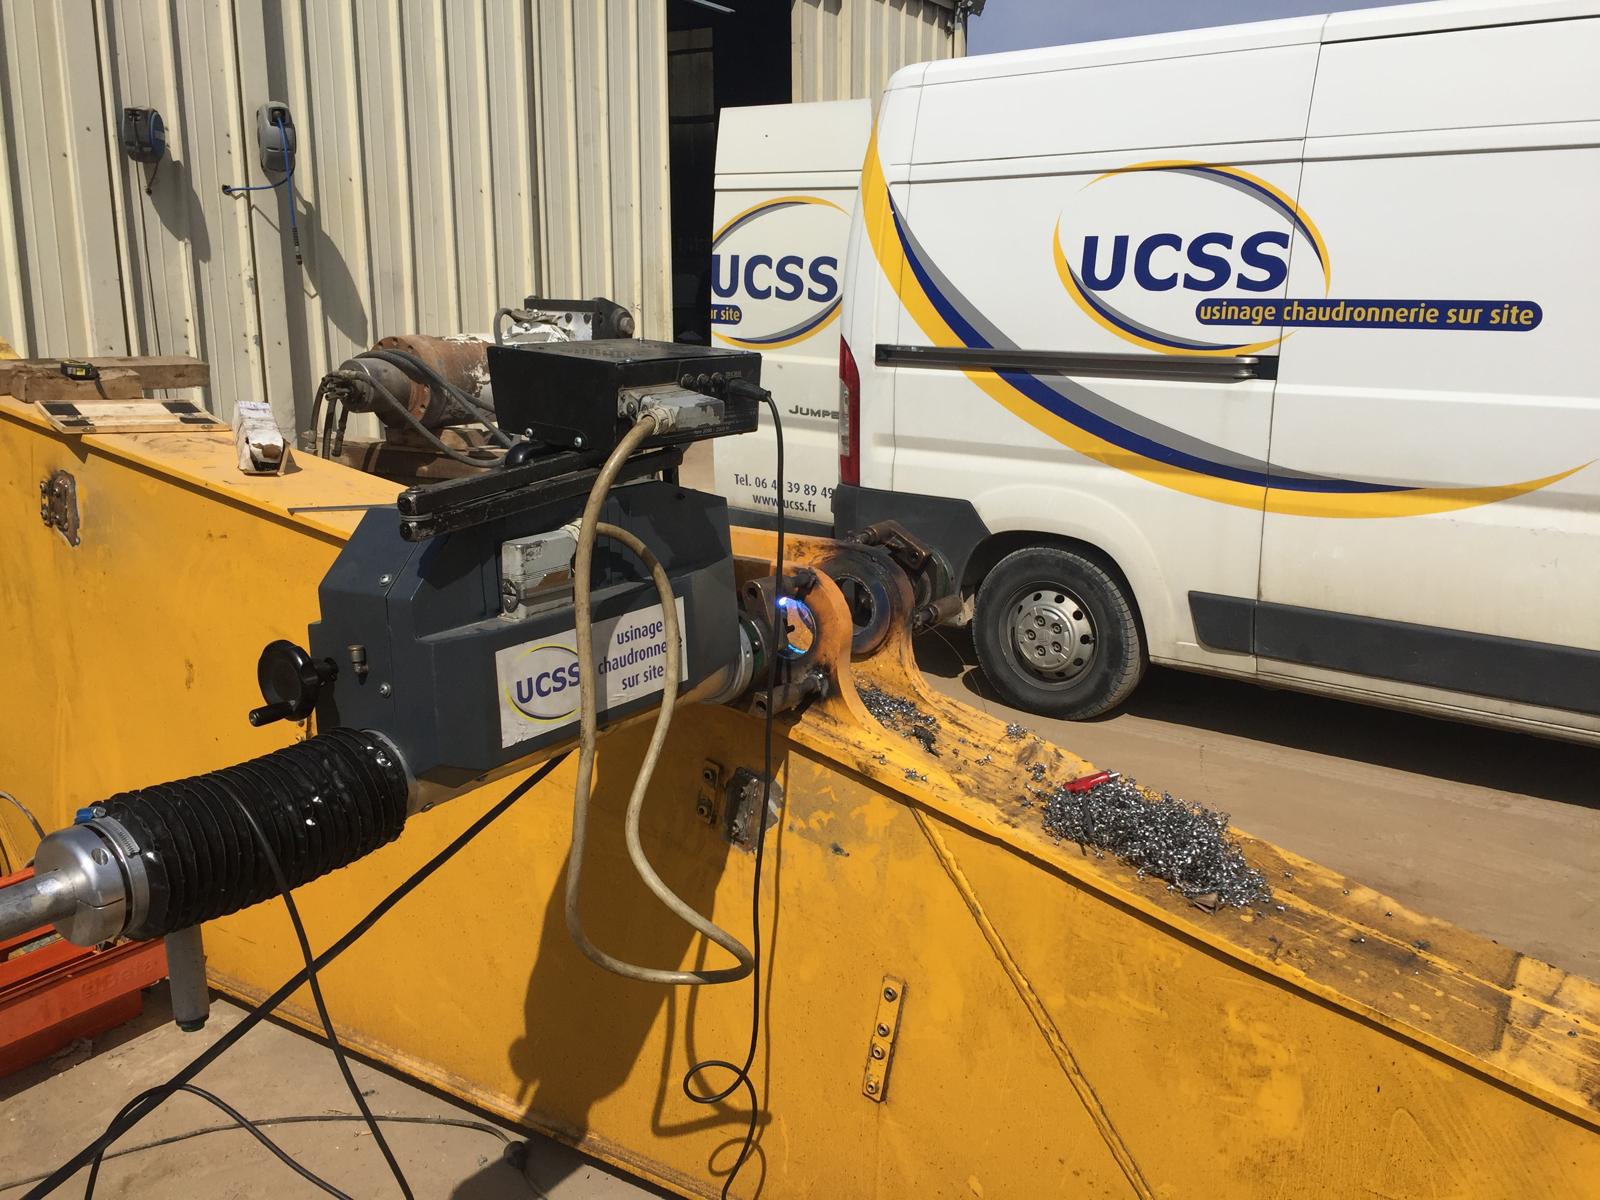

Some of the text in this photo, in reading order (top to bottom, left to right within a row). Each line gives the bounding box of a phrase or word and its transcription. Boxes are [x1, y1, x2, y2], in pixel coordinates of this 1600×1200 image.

[1080, 231, 1290, 292] UCSS
[711, 254, 838, 302] UCSS
[720, 306, 741, 321] site
[1199, 300, 1534, 326] usinage chaudronnerie sur site
[789, 405, 839, 420] JUMPE
[734, 473, 752, 487] Tel.
[754, 477, 768, 489] 06
[787, 481, 800, 494] 39
[803, 484, 817, 496] 89
[820, 487, 833, 499] 49
[752, 494, 817, 513] wwwucss.fr
[616, 620, 663, 645] usinage
[516, 662, 580, 704] UCSS
[622, 665, 665, 690] sur site
